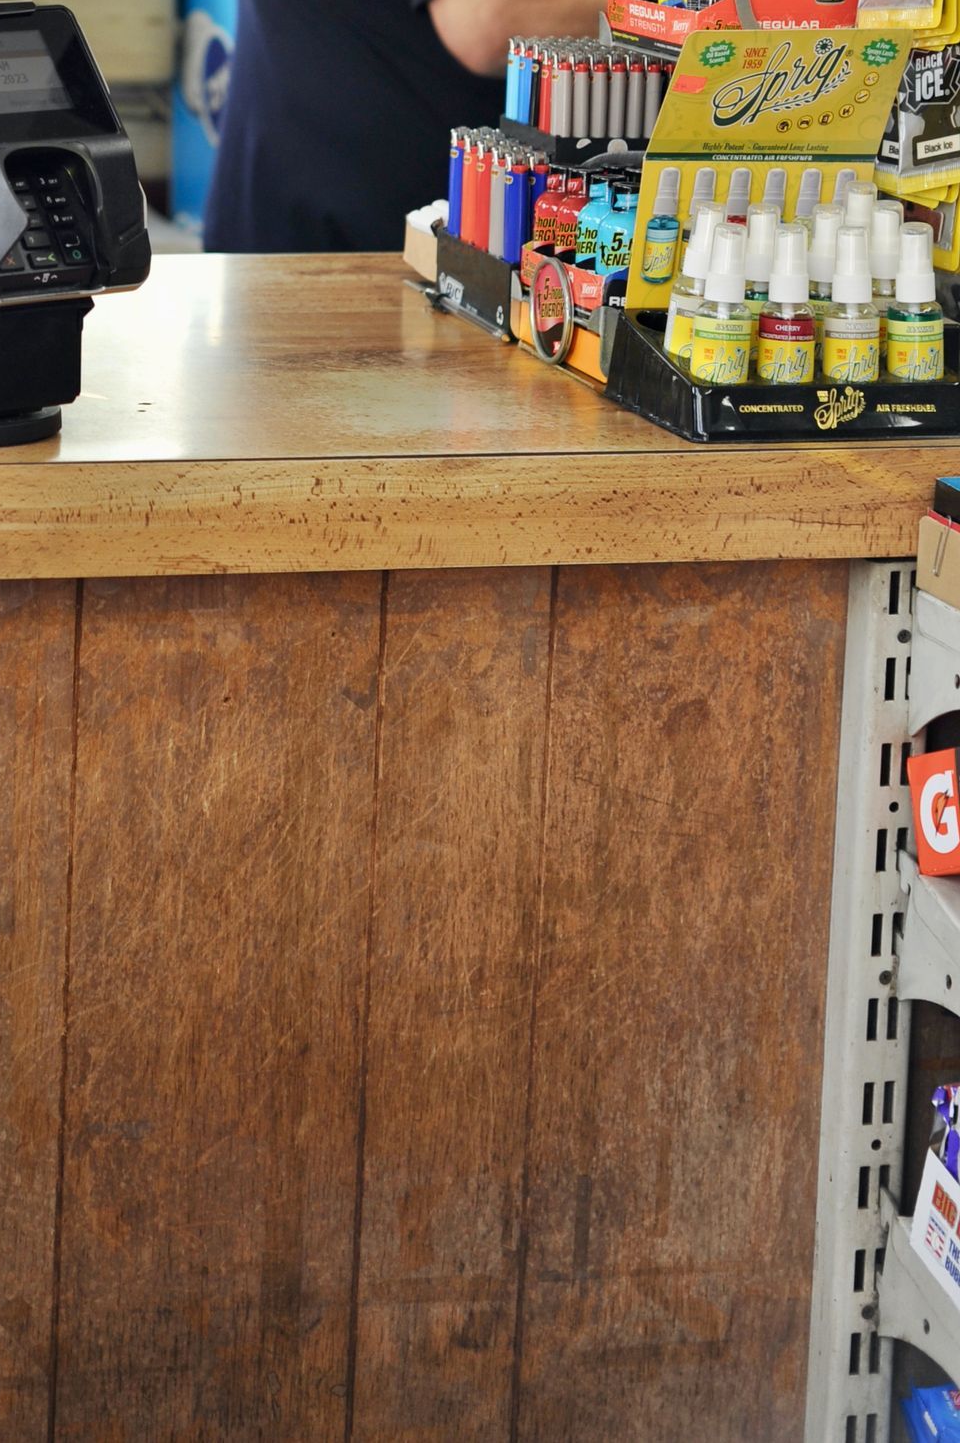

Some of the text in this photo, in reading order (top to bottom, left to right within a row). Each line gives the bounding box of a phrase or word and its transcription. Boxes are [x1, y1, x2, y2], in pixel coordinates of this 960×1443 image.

[629, 4, 666, 22] REGULAR
[630, 19, 666, 33] STRENGTH
[673, 20, 690, 33] Berry
[744, 47, 768, 58] SINCE
[742, 59, 763, 69] 1959
[915, 52, 943, 72] BLACK
[711, 40, 846, 128] Sprig
[702, 142, 829, 152] Highly Potent Guaranteed Long Lasting
[889, 144, 899, 154] Bla
[924, 140, 953, 154] Black Ice
[739, 404, 804, 413] CONCENTRATED
[814, 386, 863, 430] Sprig
[876, 404, 936, 413] AIR FRESHENER
[920, 770, 960, 854] G
[932, 1180, 958, 1229] BIG
